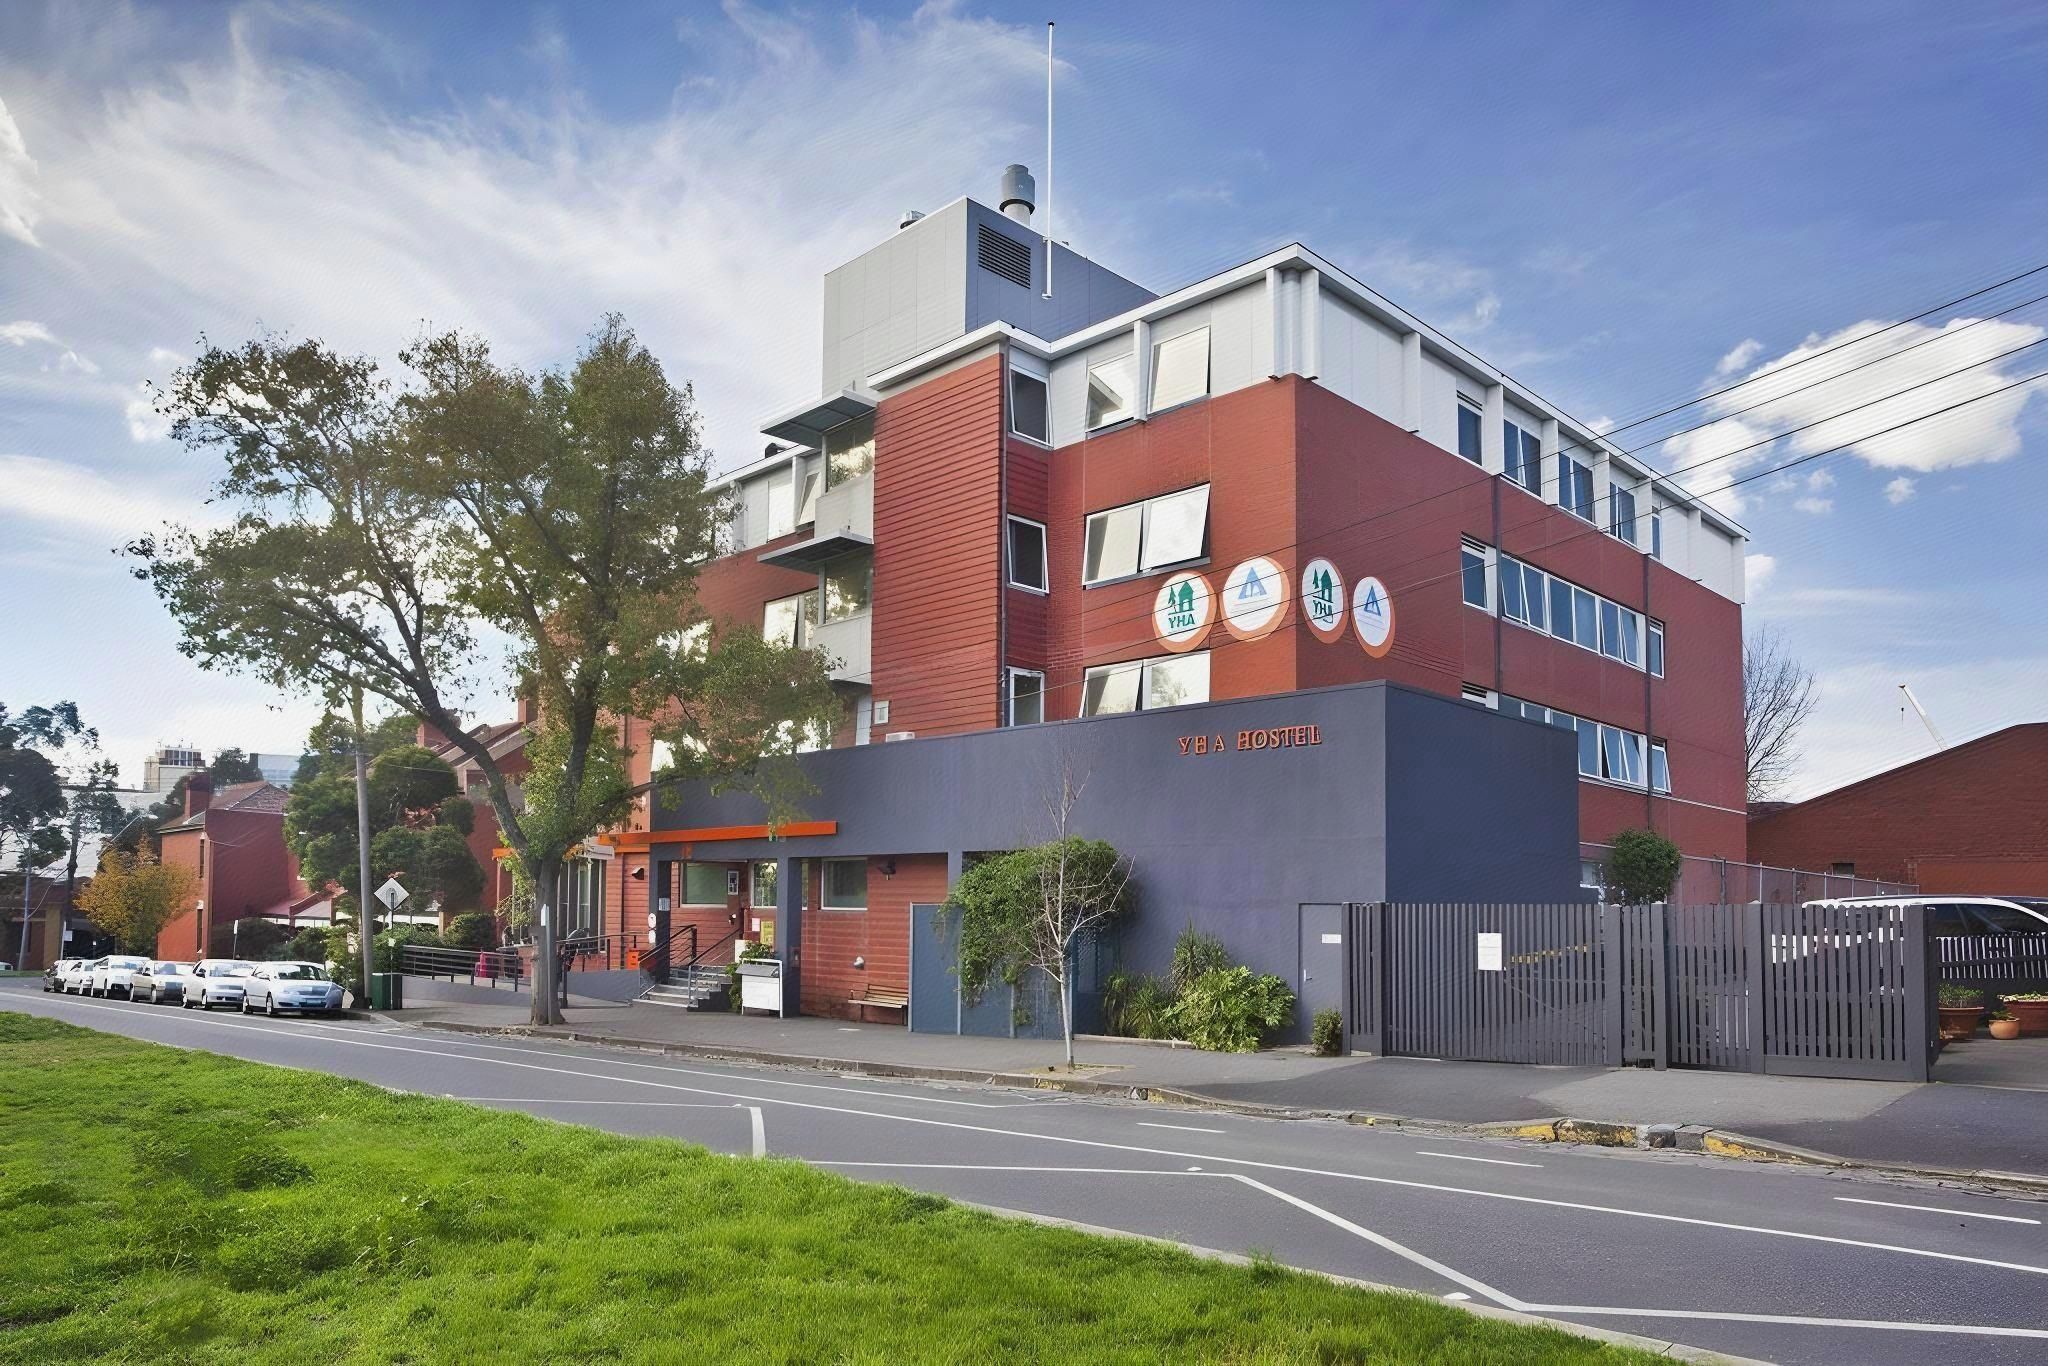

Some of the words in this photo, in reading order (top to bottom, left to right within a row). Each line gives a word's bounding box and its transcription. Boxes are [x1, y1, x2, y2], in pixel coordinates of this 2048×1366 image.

[1168, 613, 1195, 629] YHA
[1178, 735, 1226, 755] YHA
[1237, 725, 1322, 751] HOSTEL
